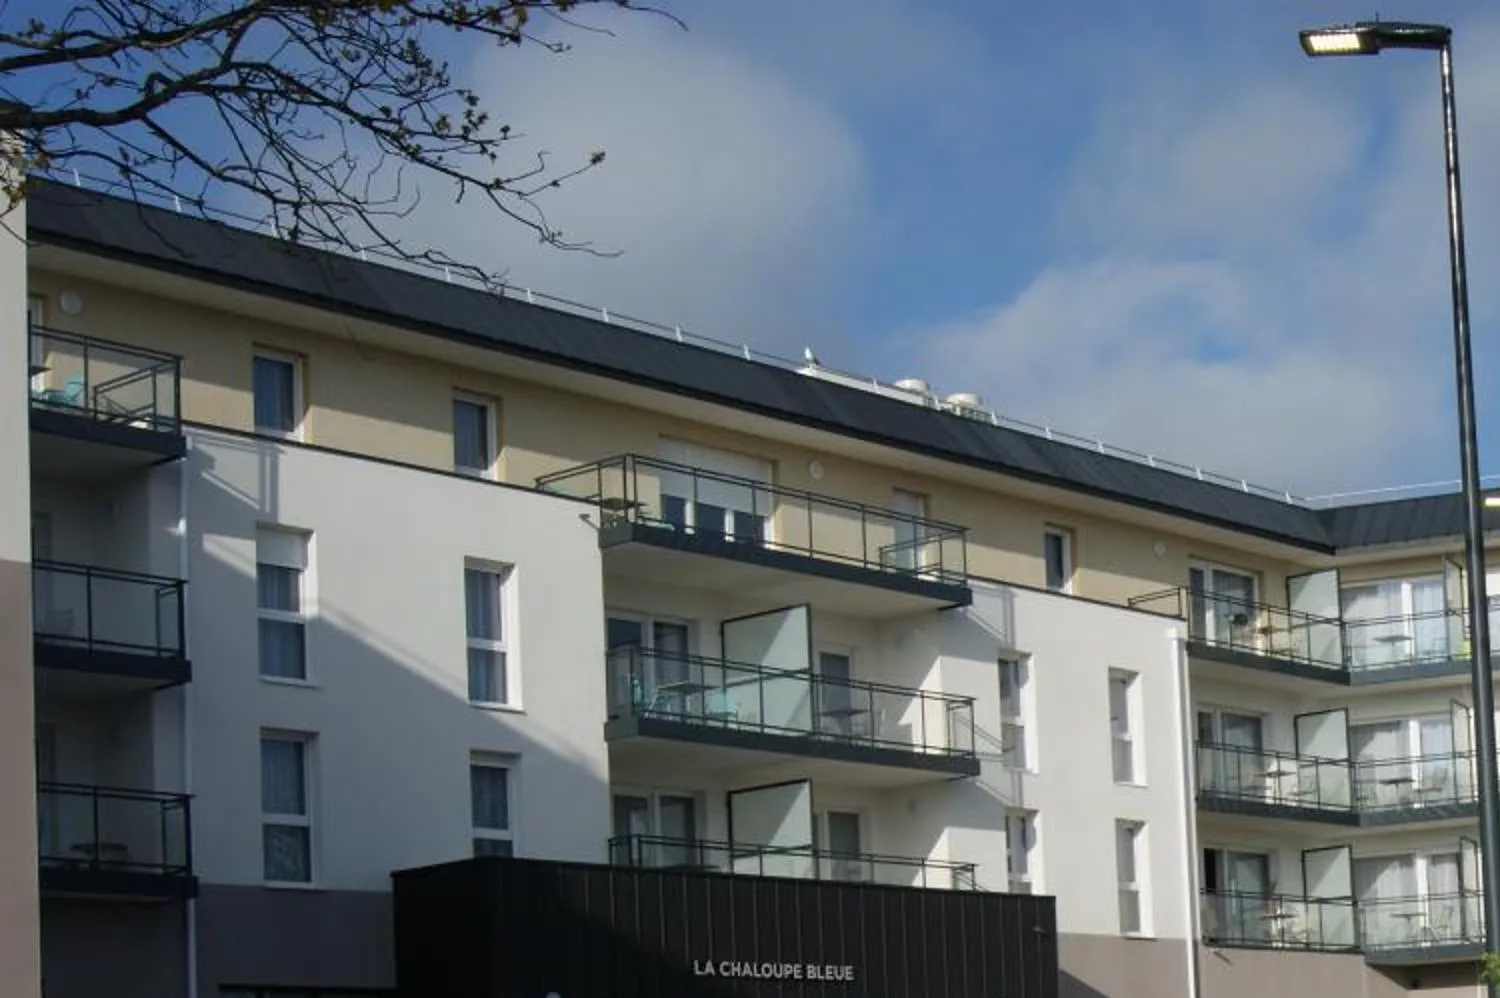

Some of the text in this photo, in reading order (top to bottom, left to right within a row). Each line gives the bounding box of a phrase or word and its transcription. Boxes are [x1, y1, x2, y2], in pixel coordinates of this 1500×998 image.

[693, 959, 855, 981] LA CHALOUPE BLEUE
